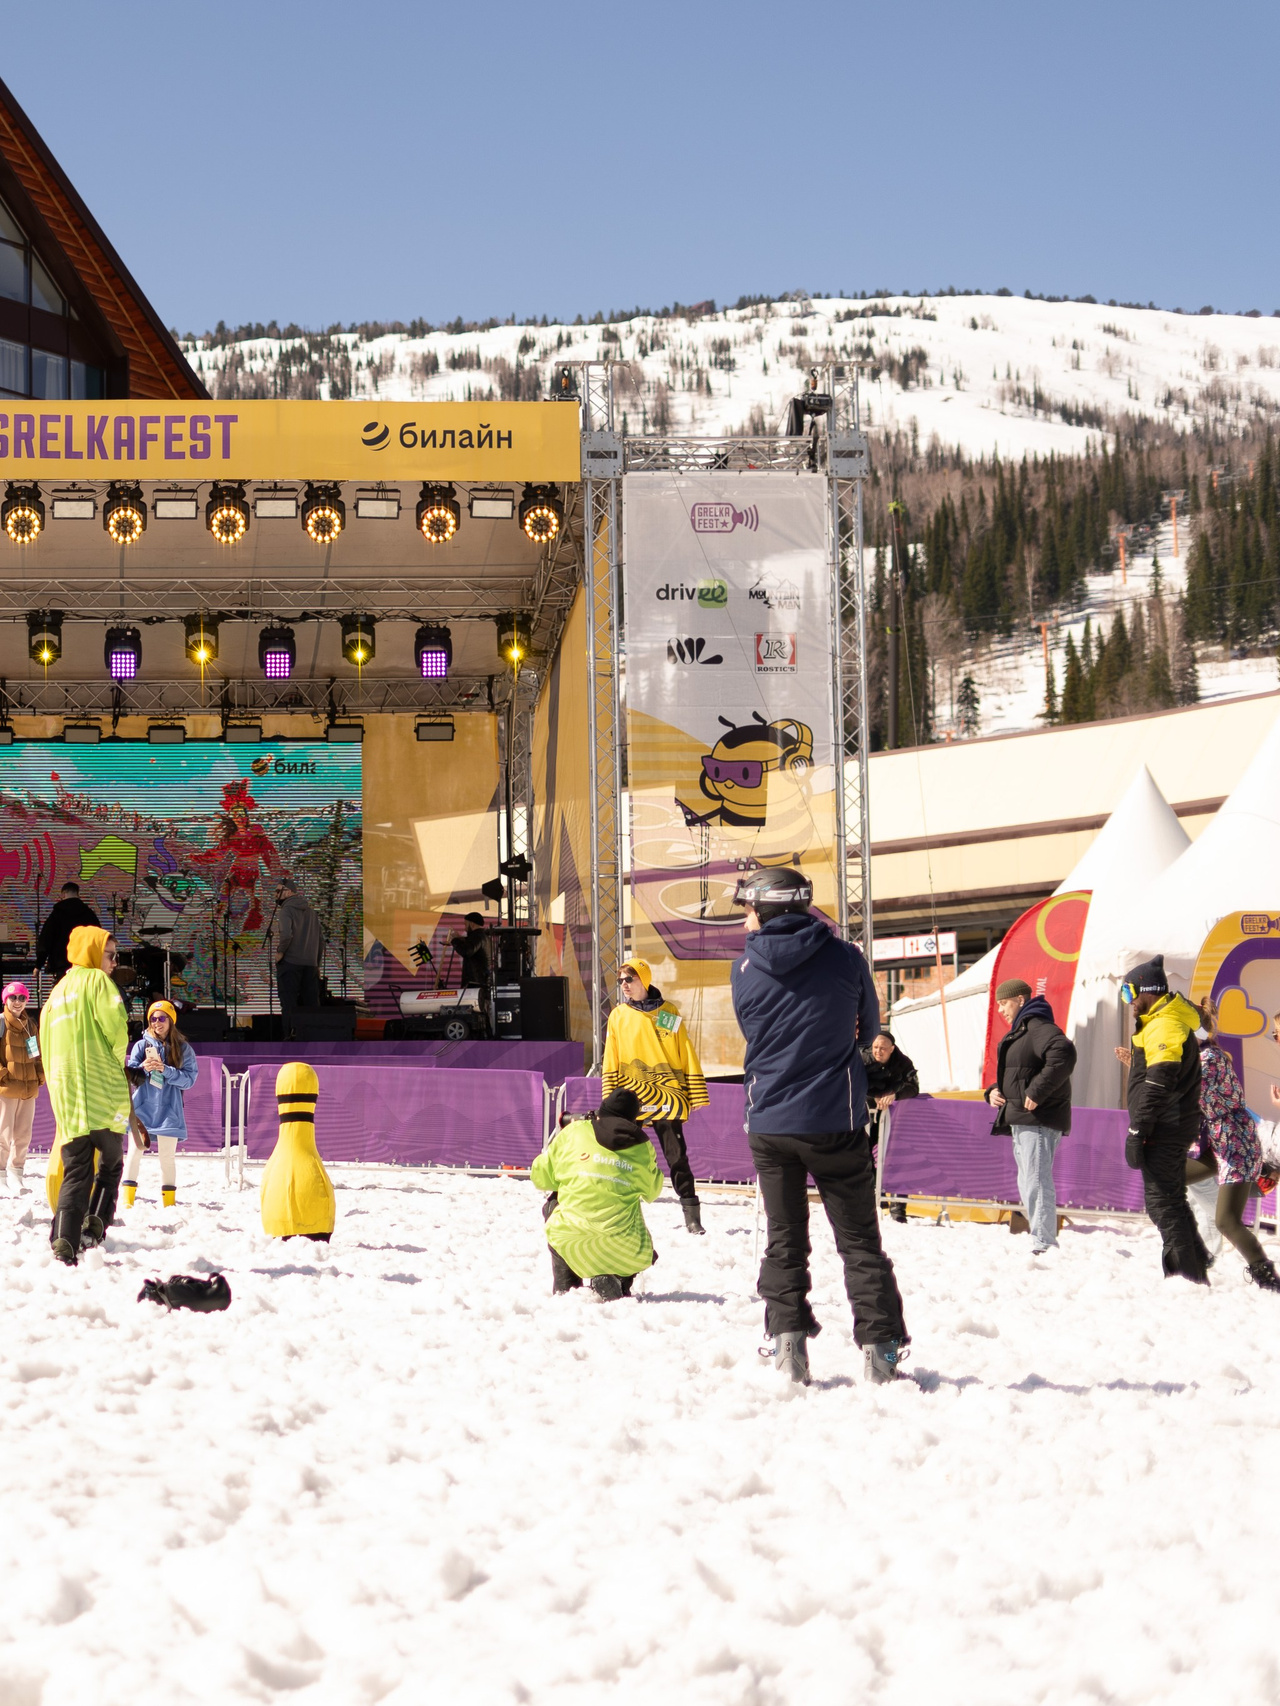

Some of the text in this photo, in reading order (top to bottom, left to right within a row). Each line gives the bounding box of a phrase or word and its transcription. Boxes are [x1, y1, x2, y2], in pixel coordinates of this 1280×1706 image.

[400, 421, 513, 449] билайн
[697, 506, 730, 518] GRELKA
[697, 518, 719, 529] FEST
[656, 583, 728, 604] drivee
[777, 601, 801, 610] MAN
[593, 1153, 633, 1172] билайн
